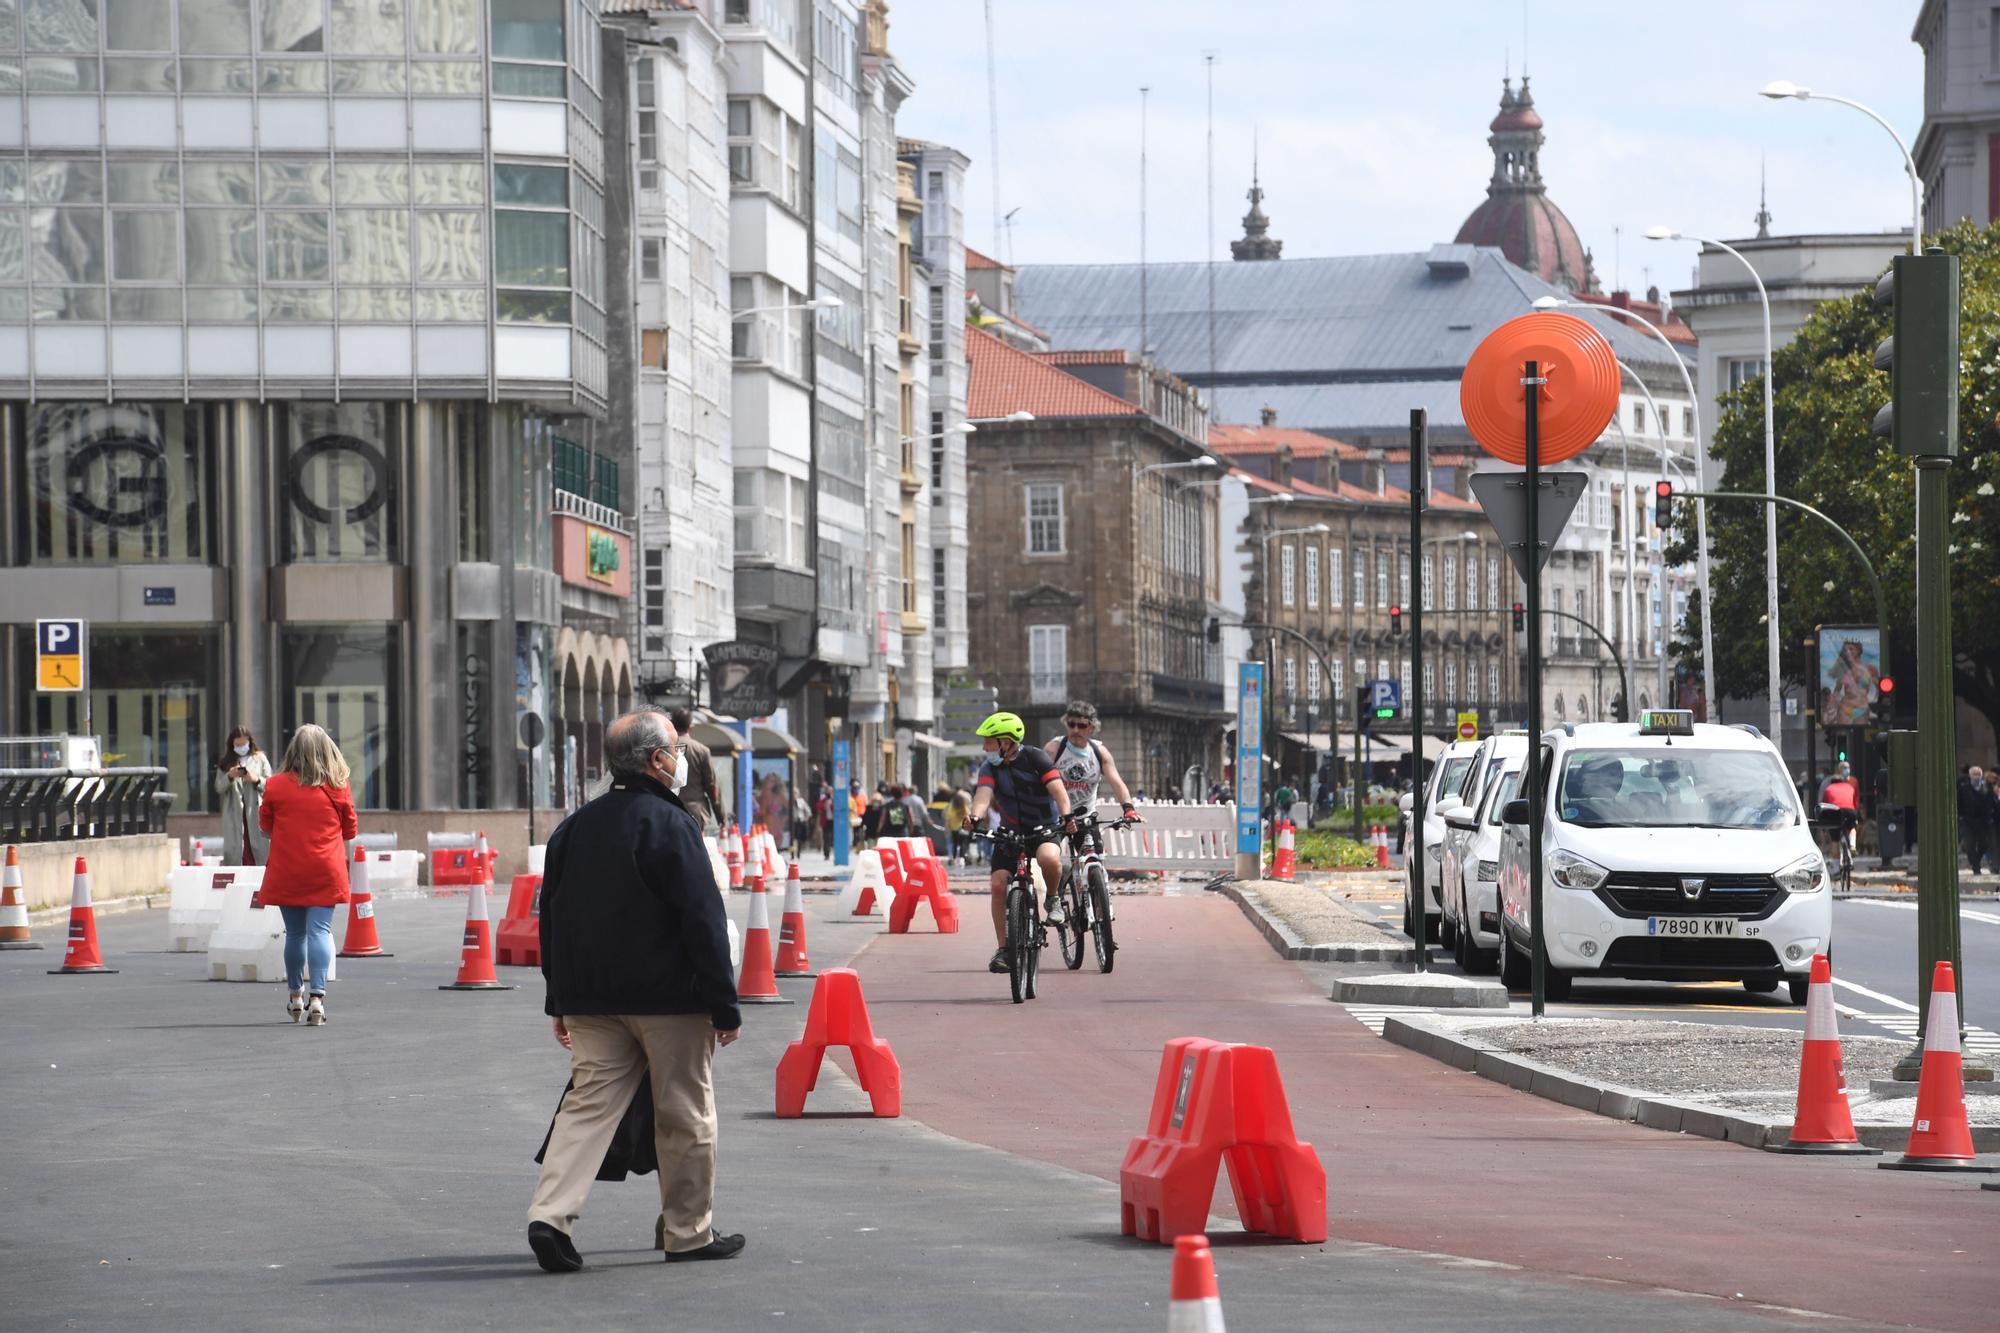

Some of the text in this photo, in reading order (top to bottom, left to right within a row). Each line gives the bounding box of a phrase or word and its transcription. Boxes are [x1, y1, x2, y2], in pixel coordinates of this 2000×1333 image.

[48, 624, 71, 652] P
[1376, 683, 1392, 706] P
[465, 654, 480, 774] MANGO
[1652, 713, 1678, 727] TAXI
[1659, 920, 1760, 936] 7890 KWV SP
